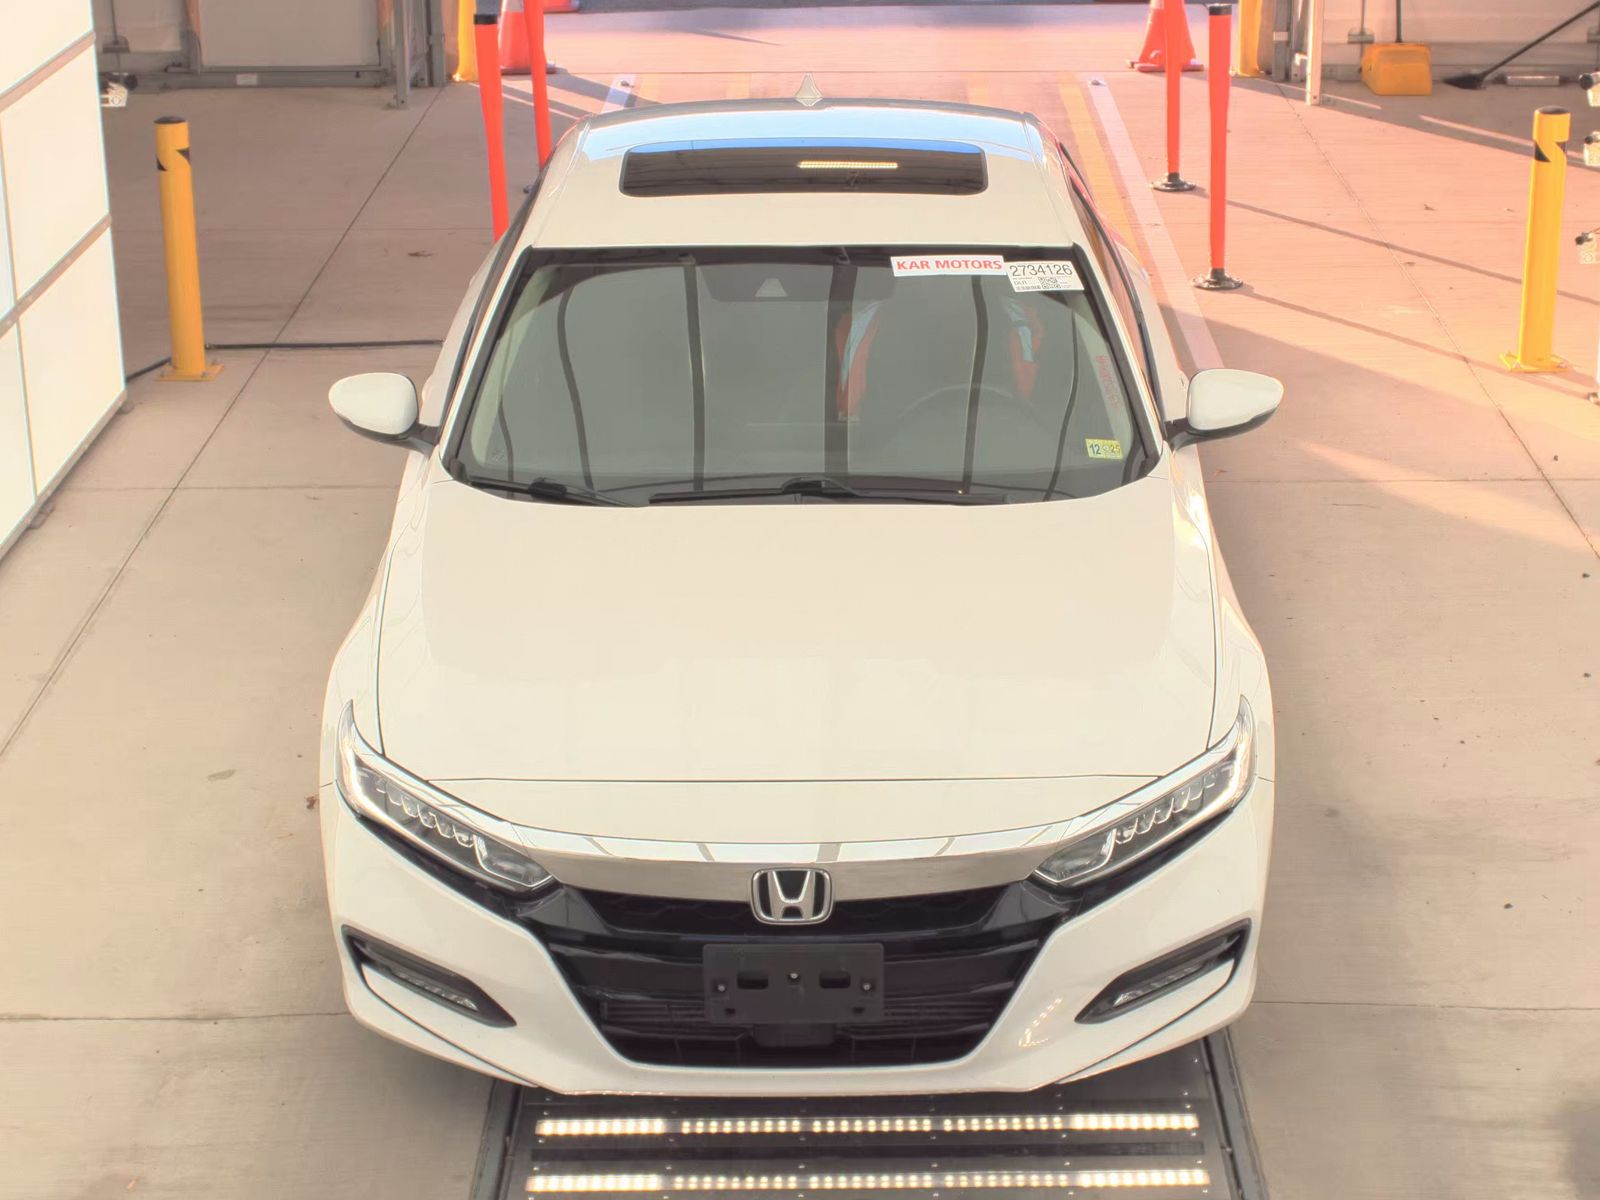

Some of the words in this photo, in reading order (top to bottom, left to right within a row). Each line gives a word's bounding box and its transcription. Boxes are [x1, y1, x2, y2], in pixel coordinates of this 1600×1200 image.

[896, 259, 930, 270] KAR
[936, 259, 1003, 270] MOTORS
[1009, 264, 1073, 277] 2734126
[1089, 443, 1101, 455] 12
